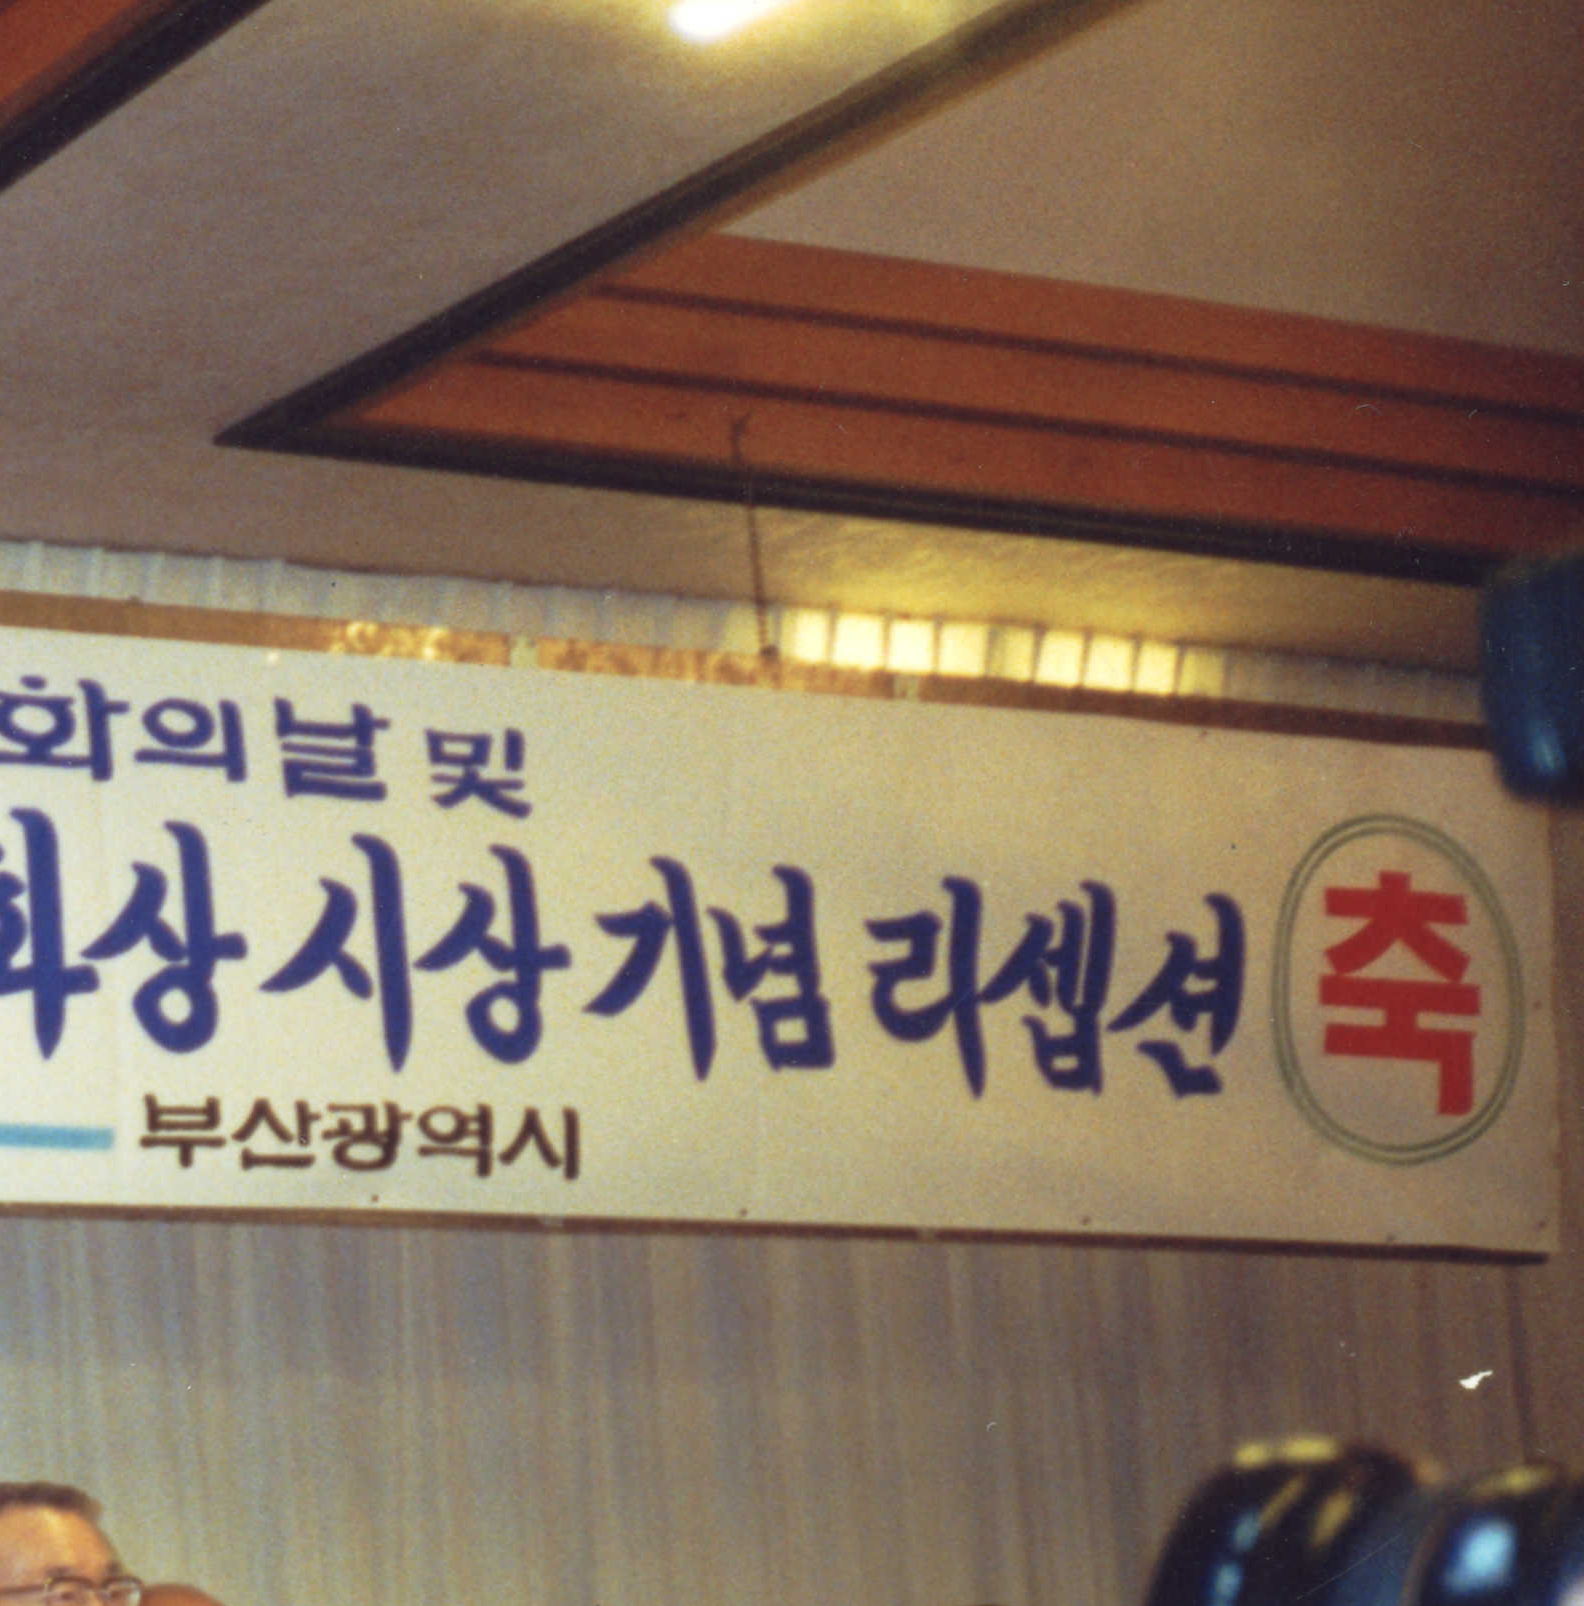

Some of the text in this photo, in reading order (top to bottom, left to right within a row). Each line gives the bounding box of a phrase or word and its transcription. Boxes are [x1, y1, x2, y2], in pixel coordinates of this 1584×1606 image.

[273, 696, 391, 802] 날
[423, 727, 533, 819] 및
[863, 874, 1246, 1099] 리셉션
[1318, 869, 1482, 1117] 축
[138, 1092, 582, 1181] 부산광역시
